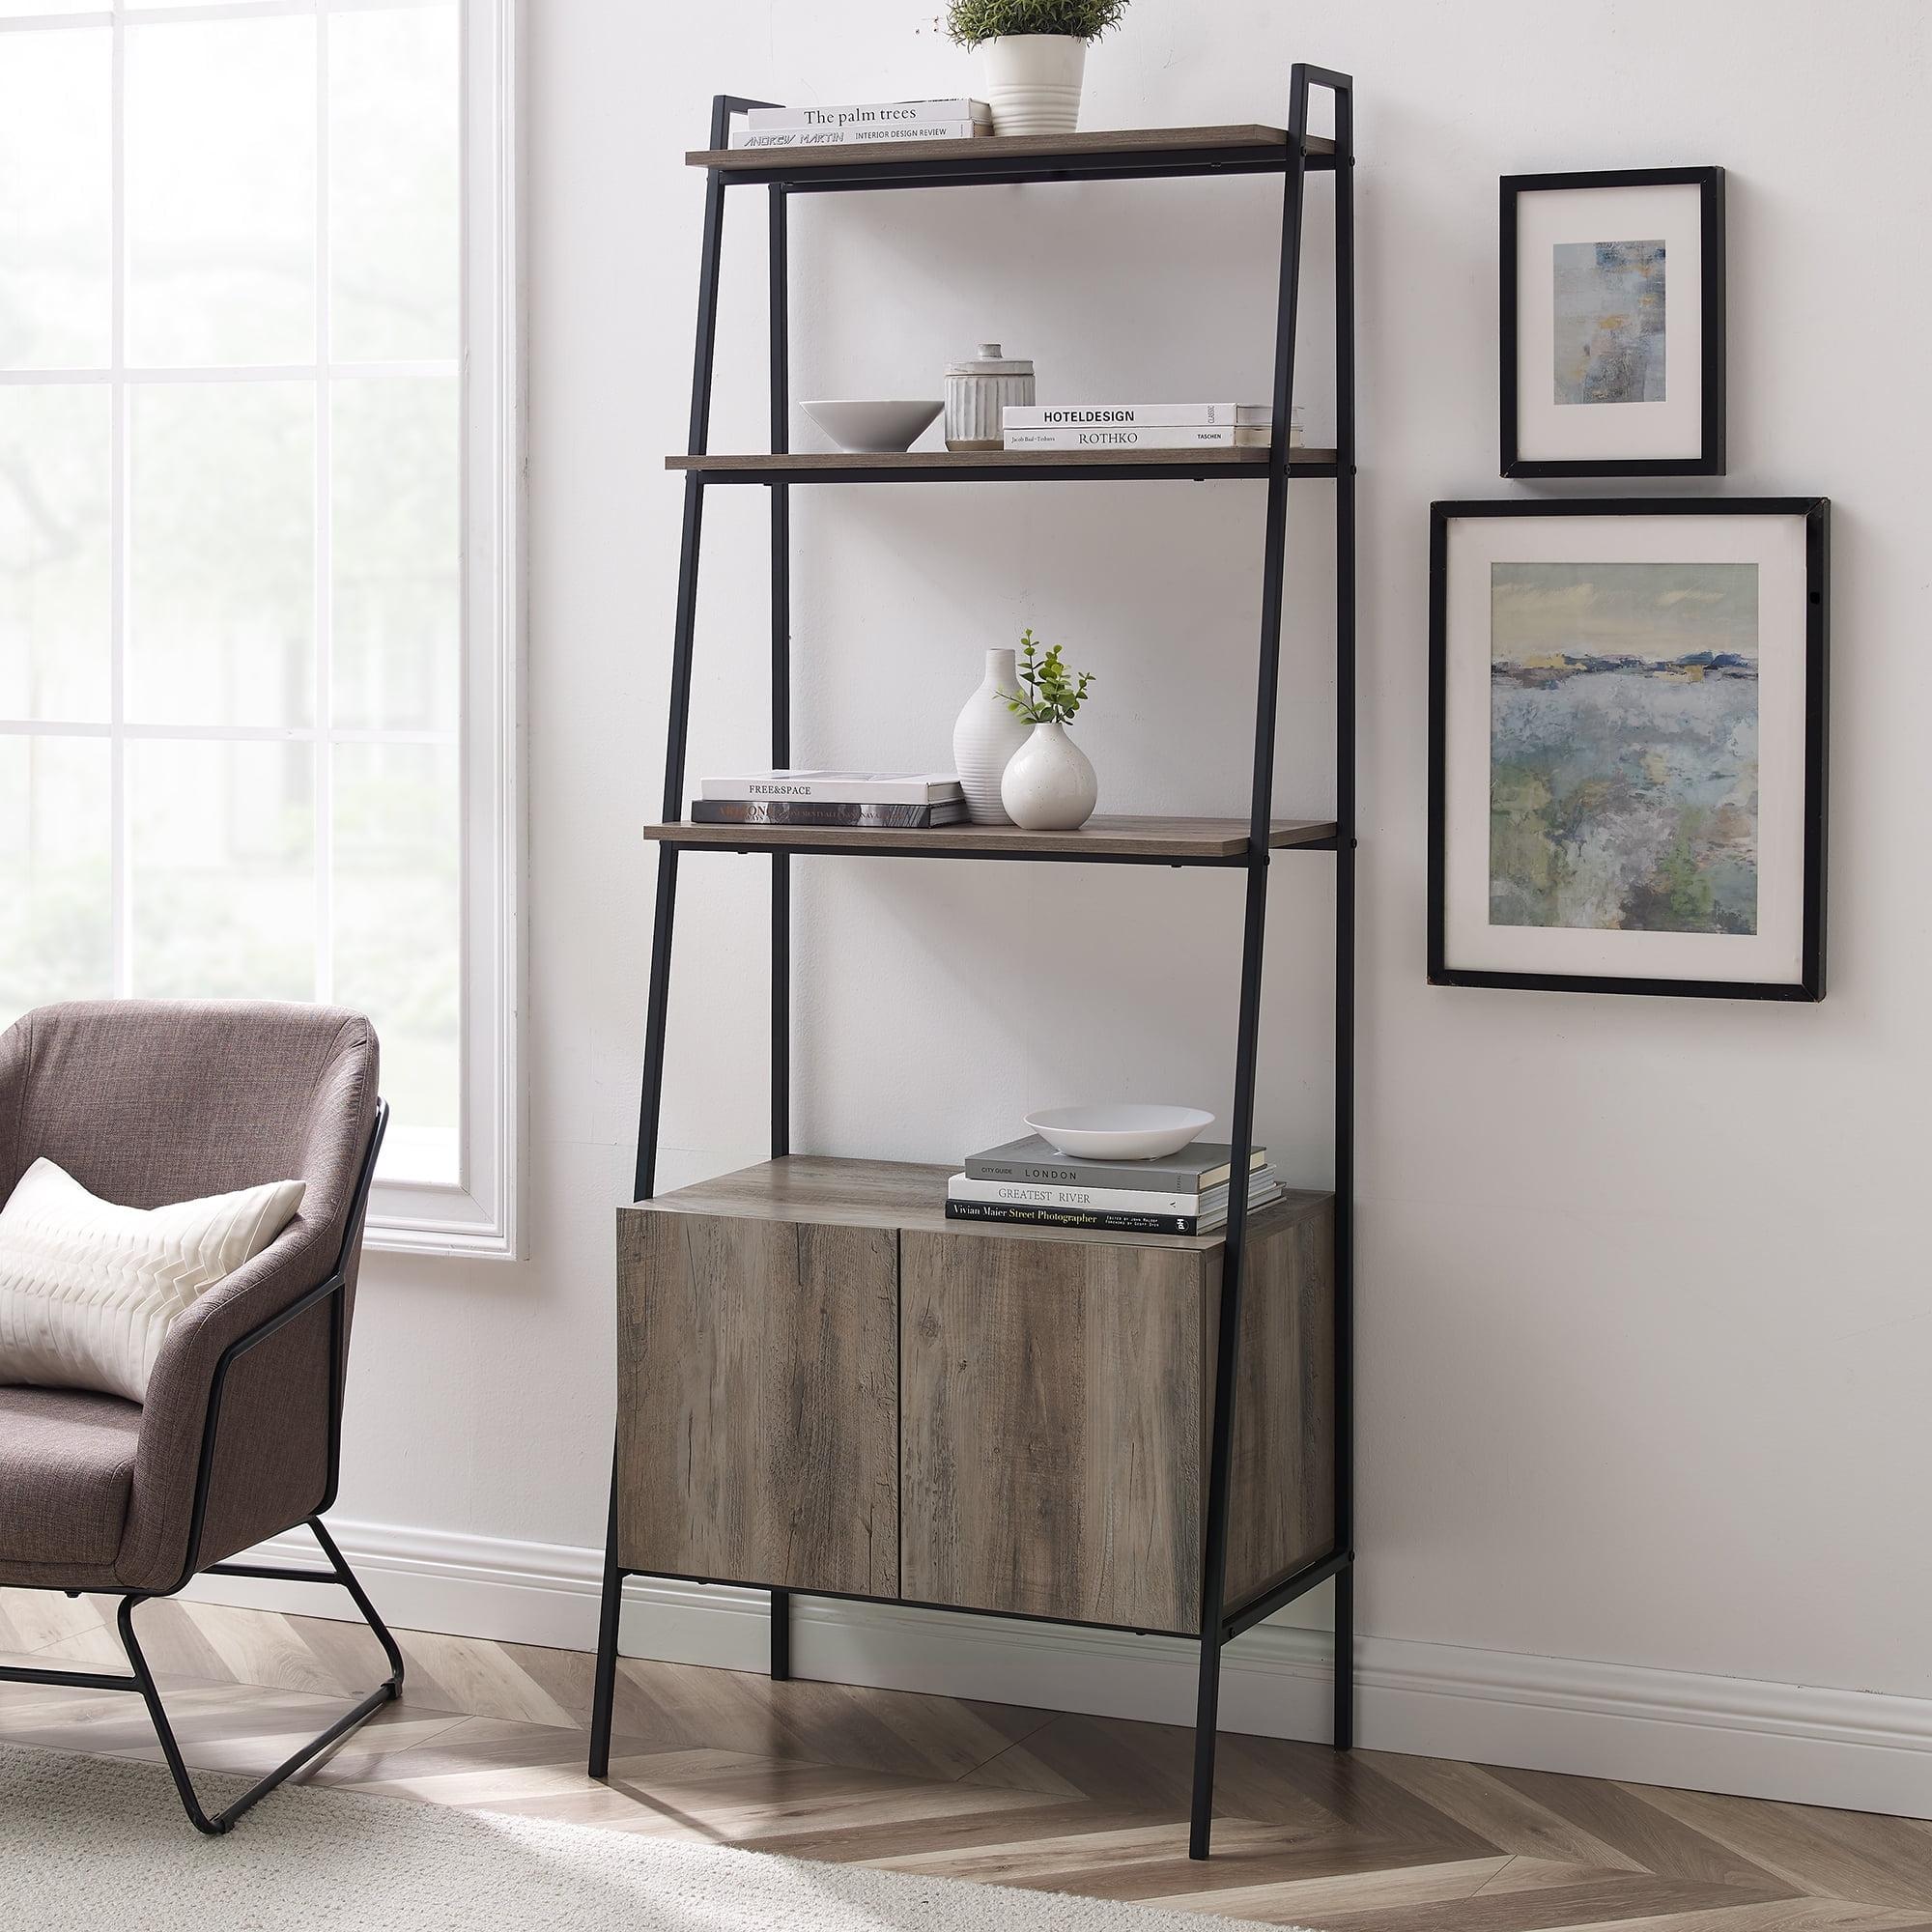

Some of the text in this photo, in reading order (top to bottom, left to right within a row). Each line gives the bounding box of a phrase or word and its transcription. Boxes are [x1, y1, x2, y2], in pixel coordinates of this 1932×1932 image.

[804, 108, 917, 127] The palm trees
[744, 134, 797, 147] ANDREW
[800, 132, 844, 144] MARTIN
[855, 130, 889, 140] INTERIOR
[891, 129, 918, 138] DESIGN
[1044, 411, 1134, 422] HOTELDESIGN
[1079, 432, 1138, 444] ROTHKO
[749, 784, 811, 795] FREE&SPACE
[1025, 1169, 1077, 1180] LONDON
[998, 1188, 1091, 1204] GREATEST RIVER
[953, 1205, 1097, 1225] Vivian Maier Street Photographer
